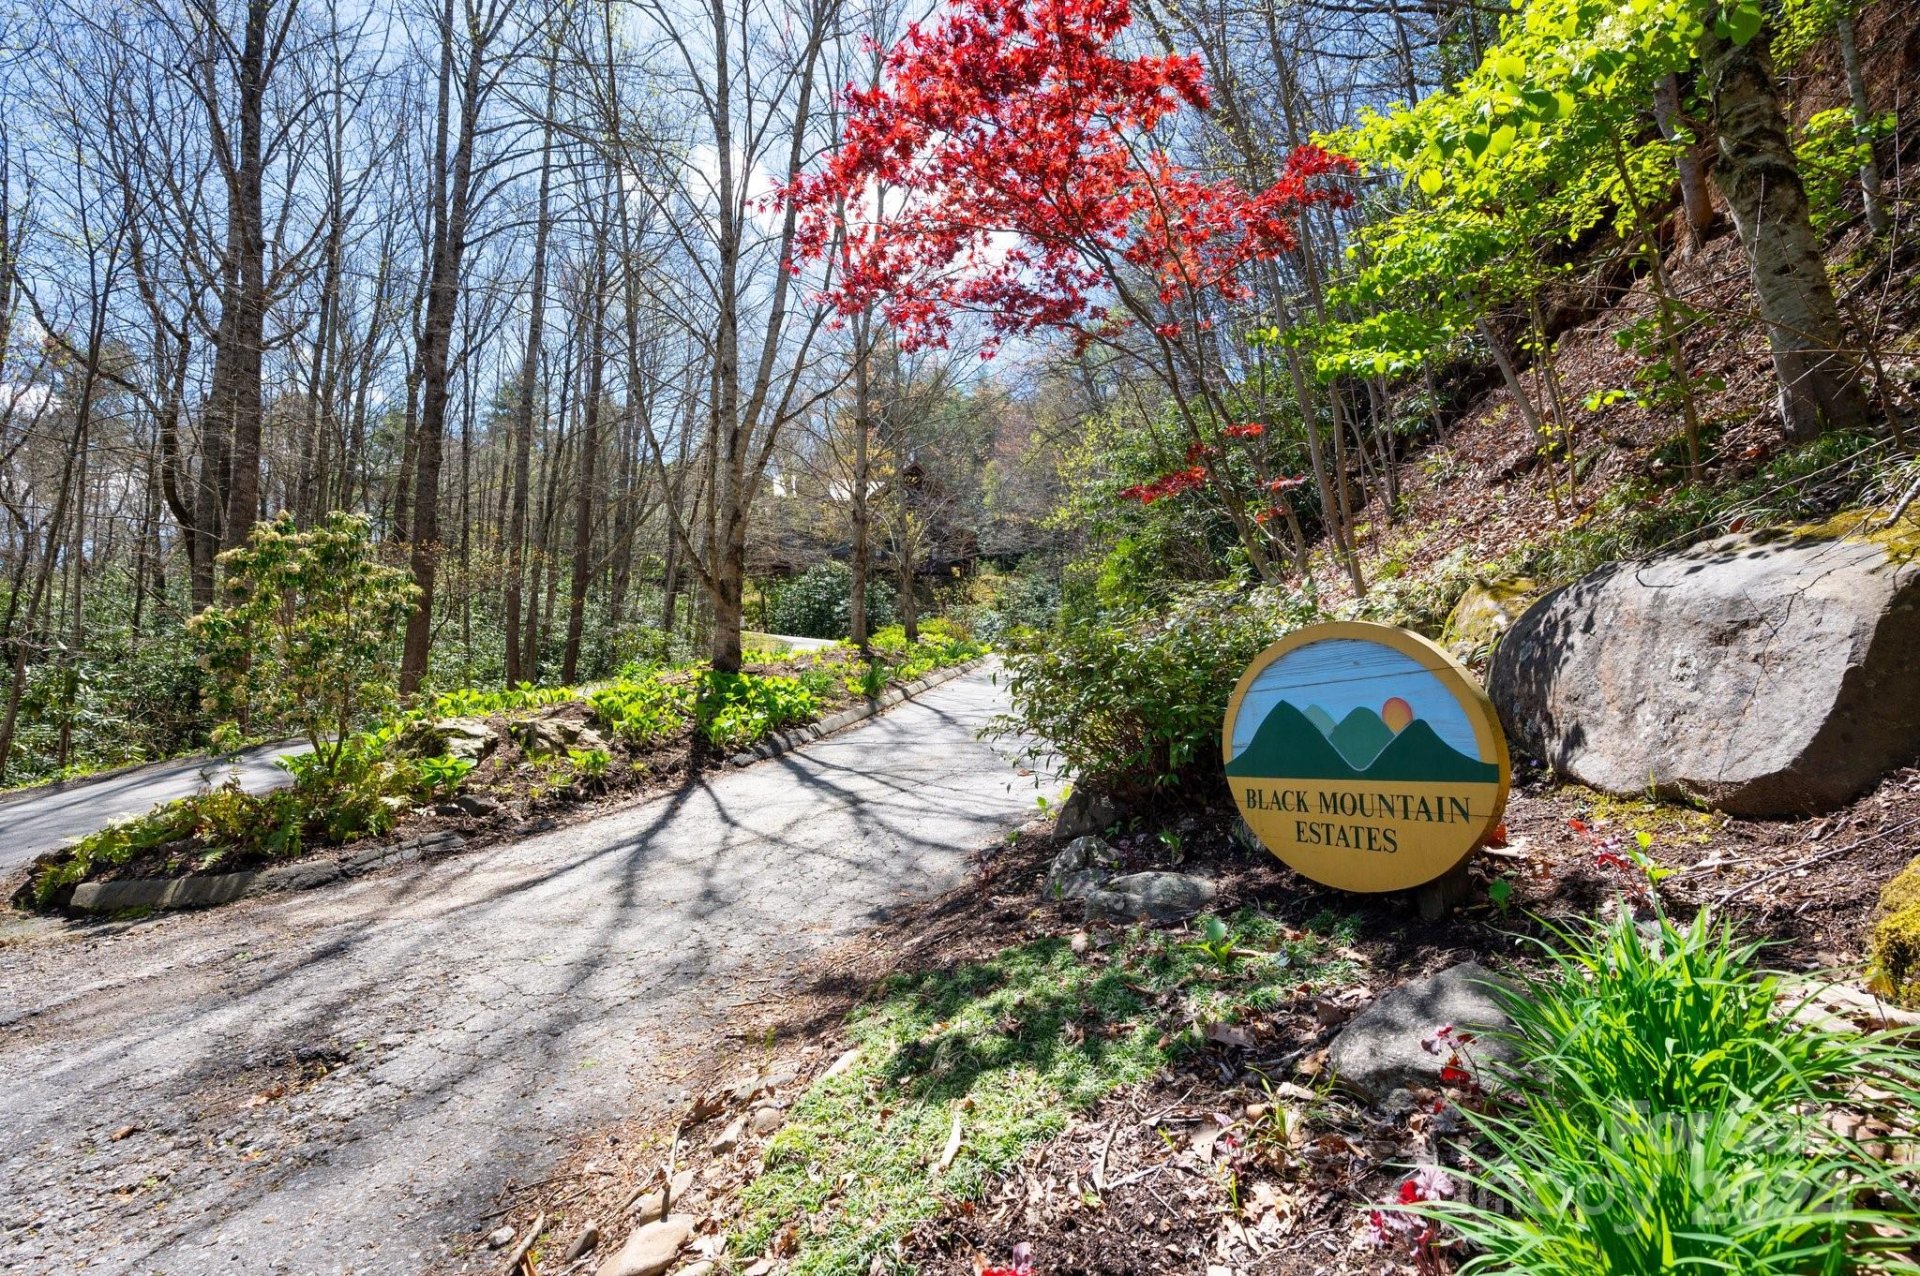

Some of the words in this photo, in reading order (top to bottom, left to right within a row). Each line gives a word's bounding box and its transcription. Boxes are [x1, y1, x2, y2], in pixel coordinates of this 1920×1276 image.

[1246, 788, 1310, 813] BLACK
[1319, 791, 1471, 825] MOUNTAIN
[1295, 820, 1398, 854] ESTATES
